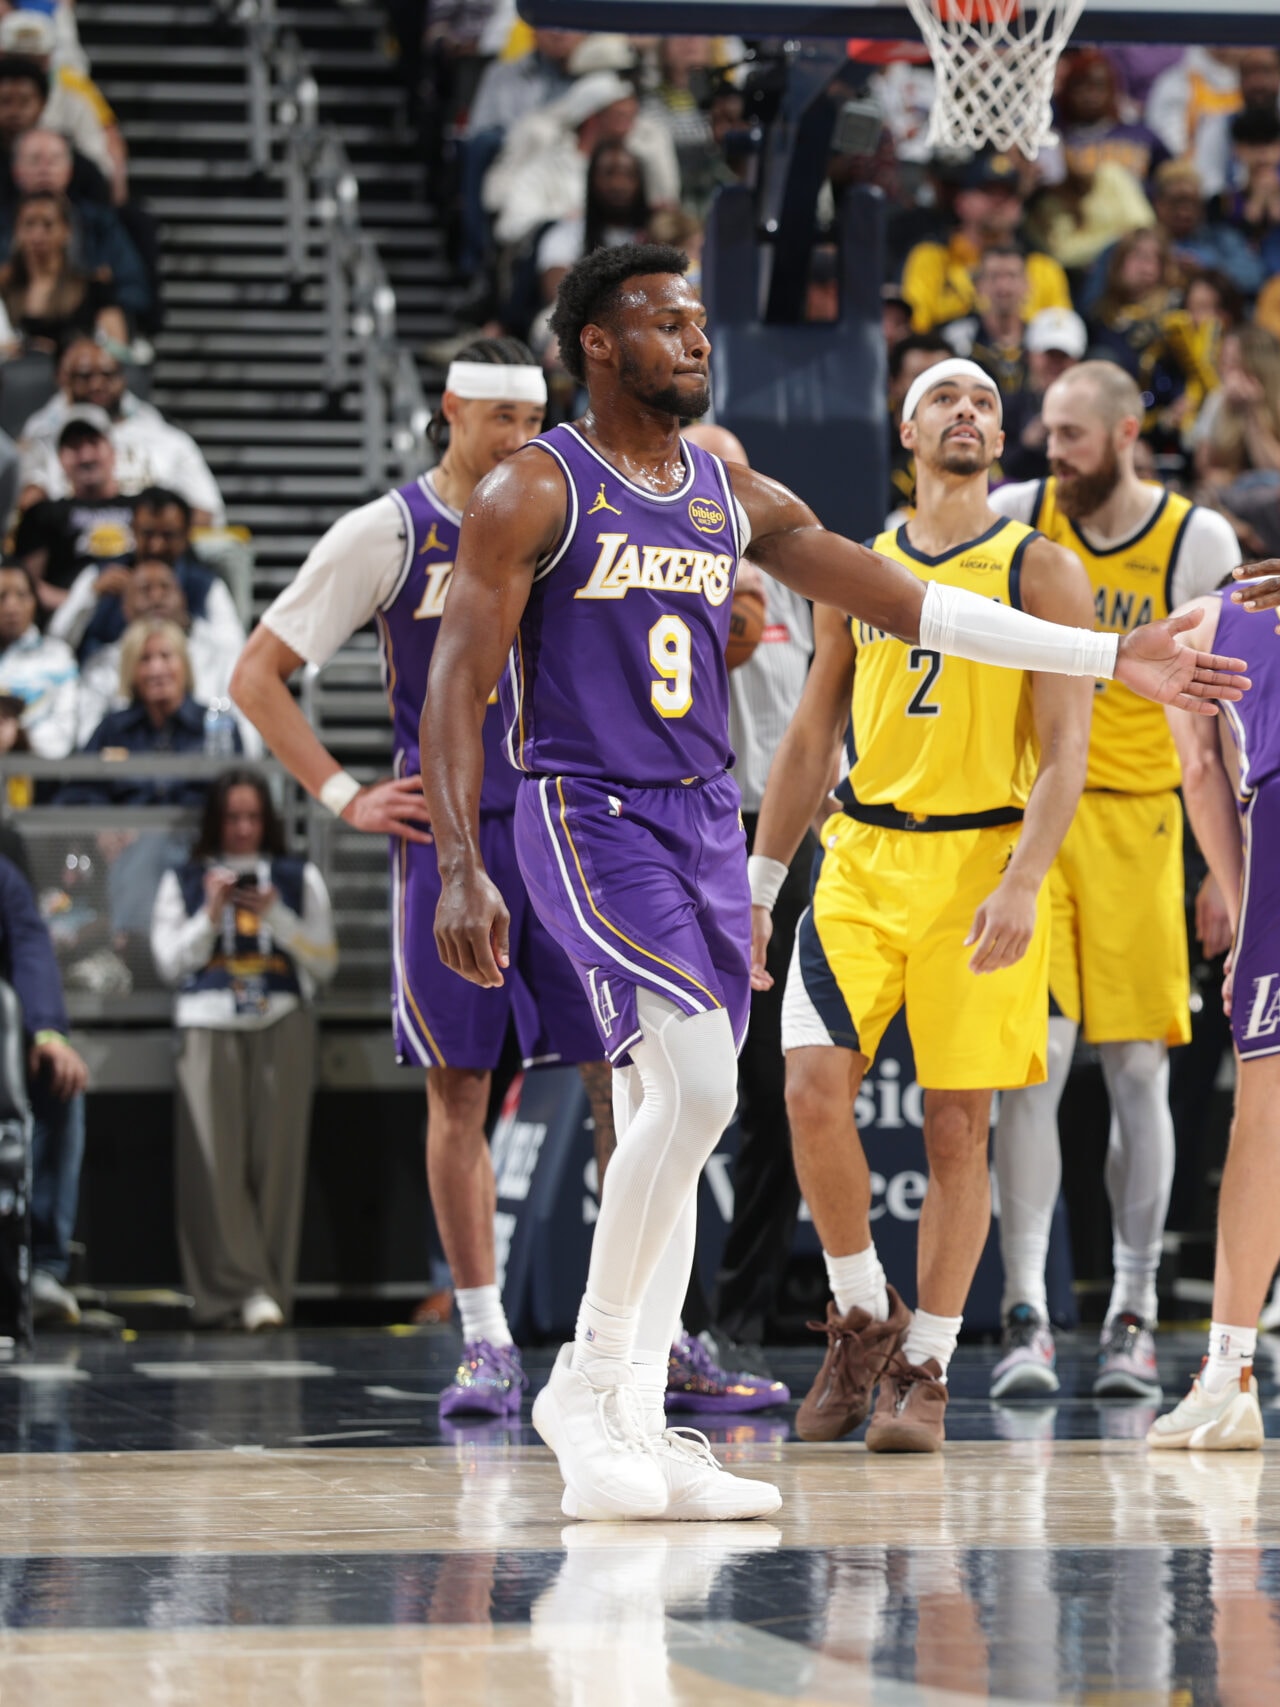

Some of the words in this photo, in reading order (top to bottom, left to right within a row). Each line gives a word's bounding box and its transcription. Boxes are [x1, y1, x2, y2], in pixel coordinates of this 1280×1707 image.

[691, 505, 722, 524] bibigo
[574, 533, 735, 606] LAKERS
[649, 614, 693, 718] 9
[905, 646, 944, 717] 2
